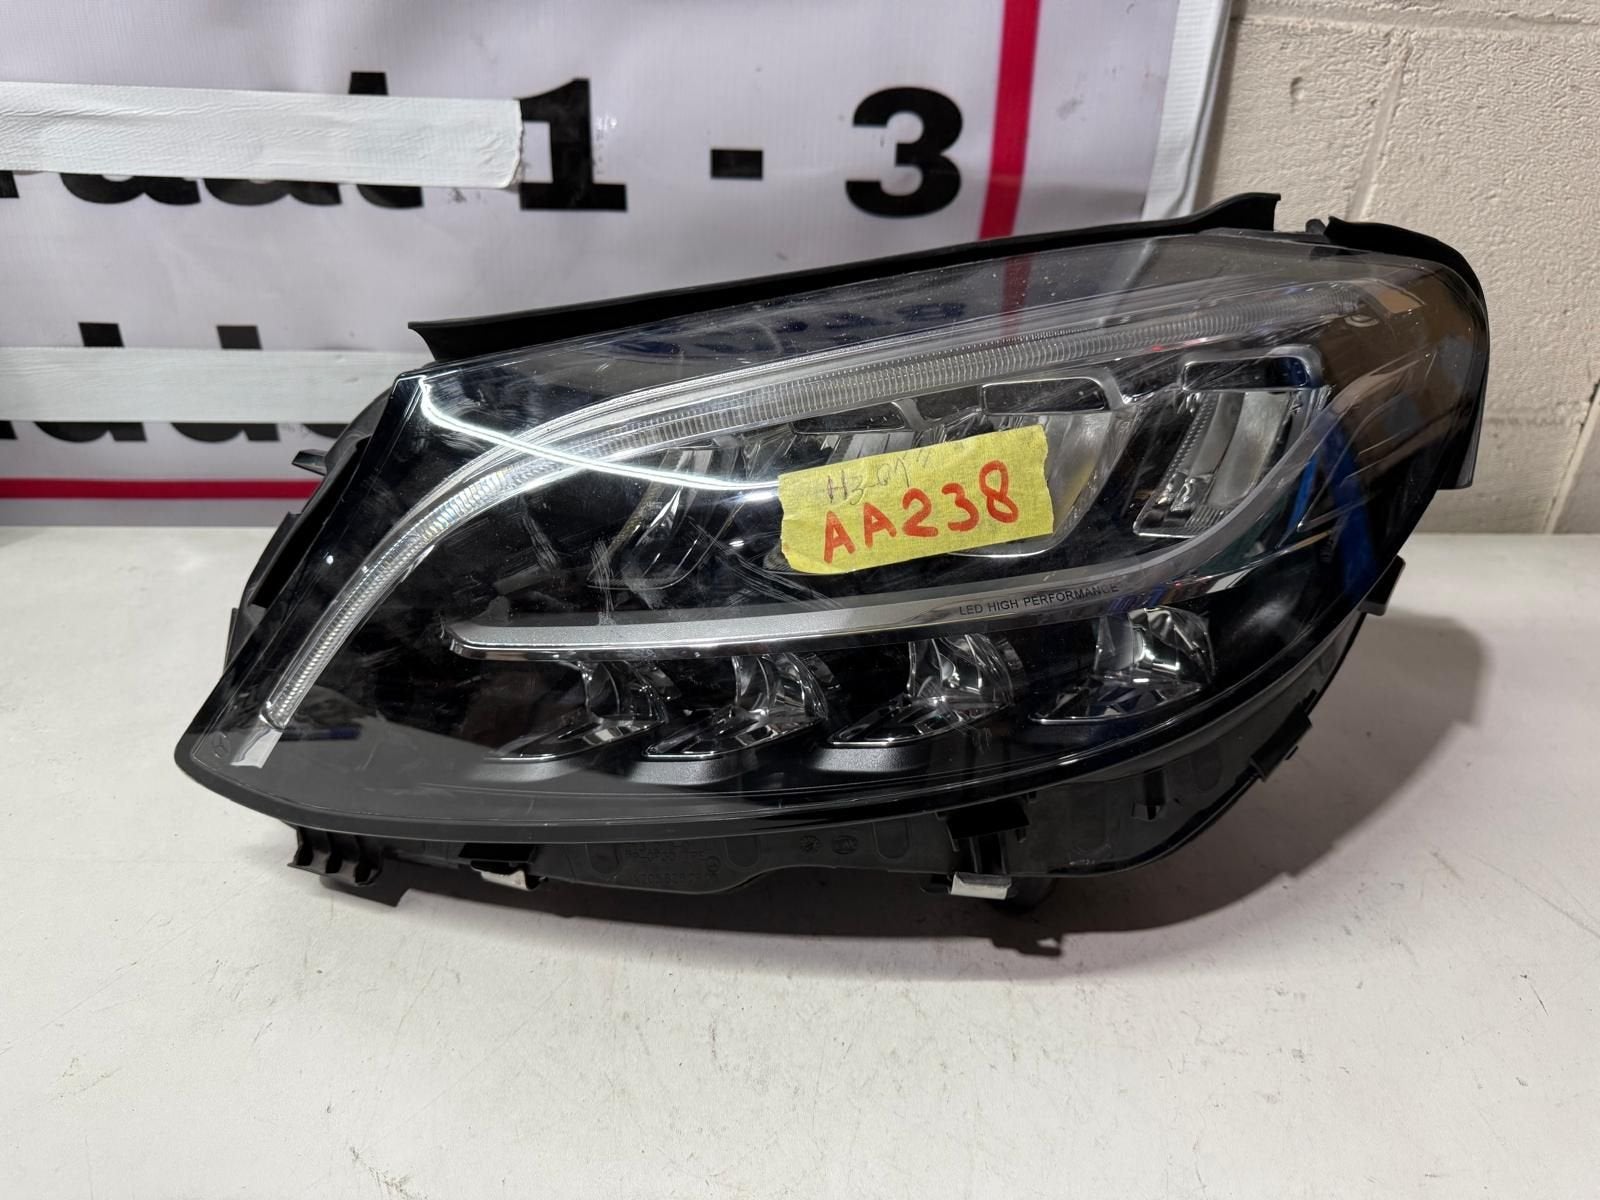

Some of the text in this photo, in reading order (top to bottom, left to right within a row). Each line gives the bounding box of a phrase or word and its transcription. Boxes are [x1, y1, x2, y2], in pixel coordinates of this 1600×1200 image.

[519, 78, 628, 212] 1
[710, 148, 764, 180] -
[845, 86, 964, 219] 3
[823, 460, 1018, 563] AA238
[959, 584, 1119, 616] LED HIGH PERFORMANCE
